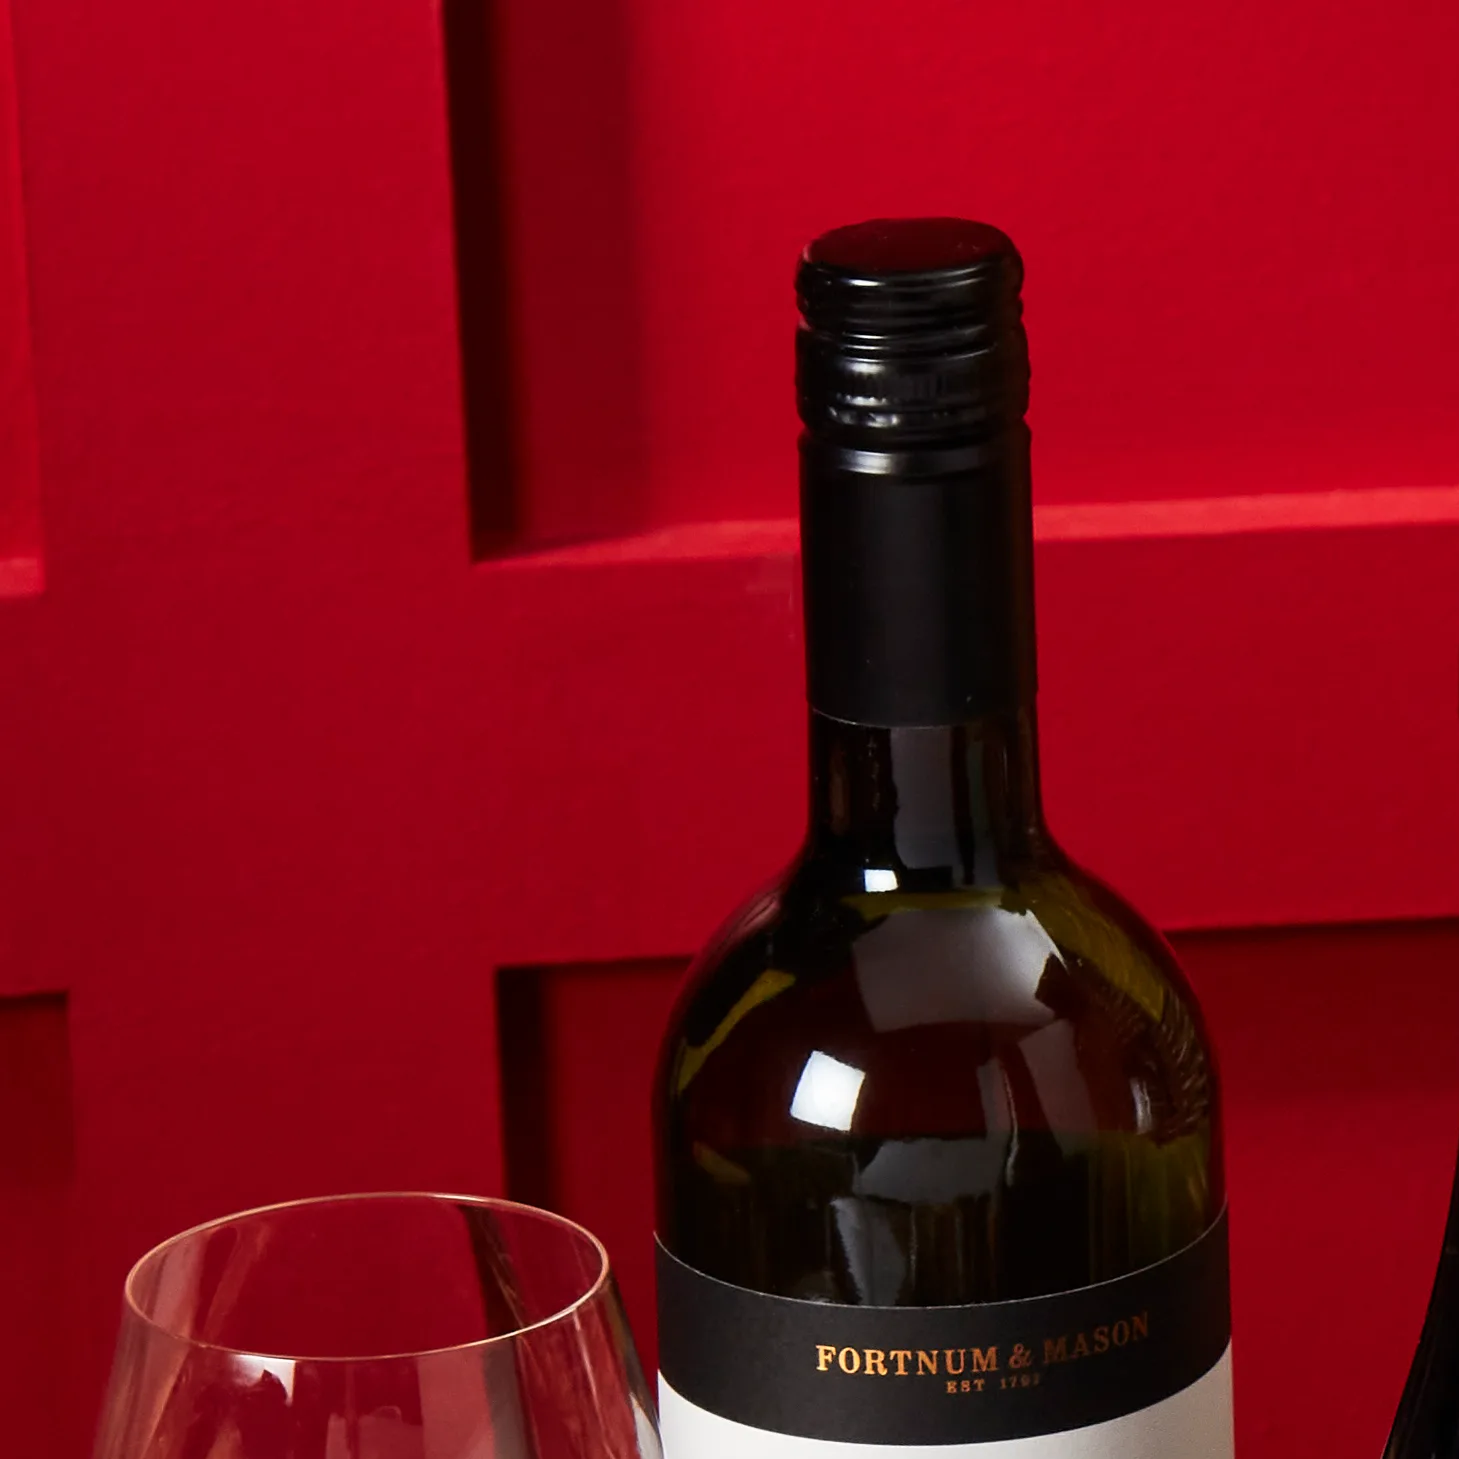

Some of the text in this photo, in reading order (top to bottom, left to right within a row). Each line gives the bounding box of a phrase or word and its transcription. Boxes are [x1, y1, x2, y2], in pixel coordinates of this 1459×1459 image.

[816, 1311, 1149, 1376] FORTNUM & MASON
